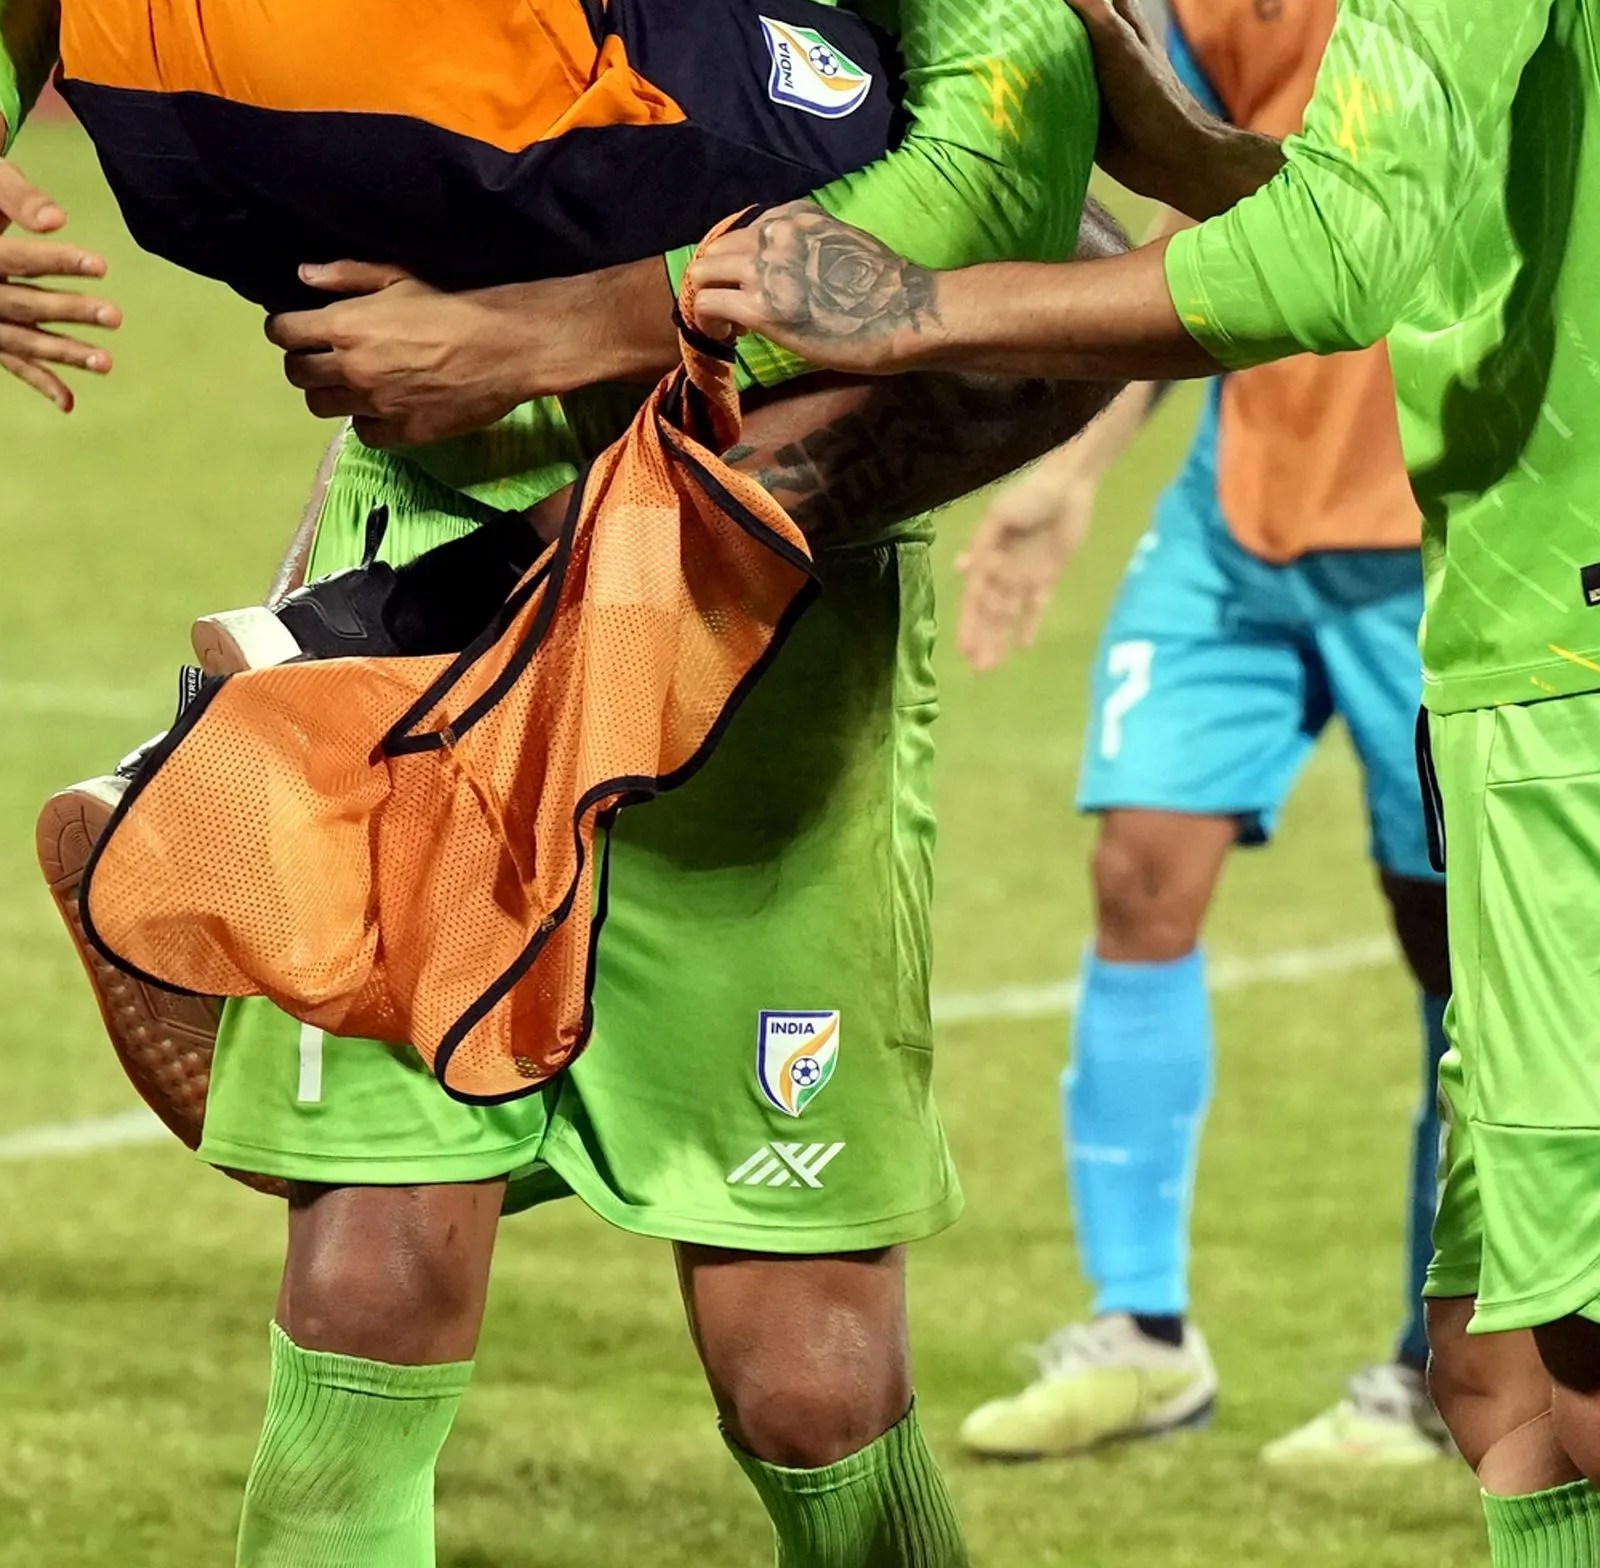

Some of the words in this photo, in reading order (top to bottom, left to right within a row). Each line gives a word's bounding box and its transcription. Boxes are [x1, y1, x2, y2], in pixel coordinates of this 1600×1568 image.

[780, 42, 794, 88] INDIA
[1100, 639, 1156, 761] 7
[771, 1022, 815, 1034] INDIA
